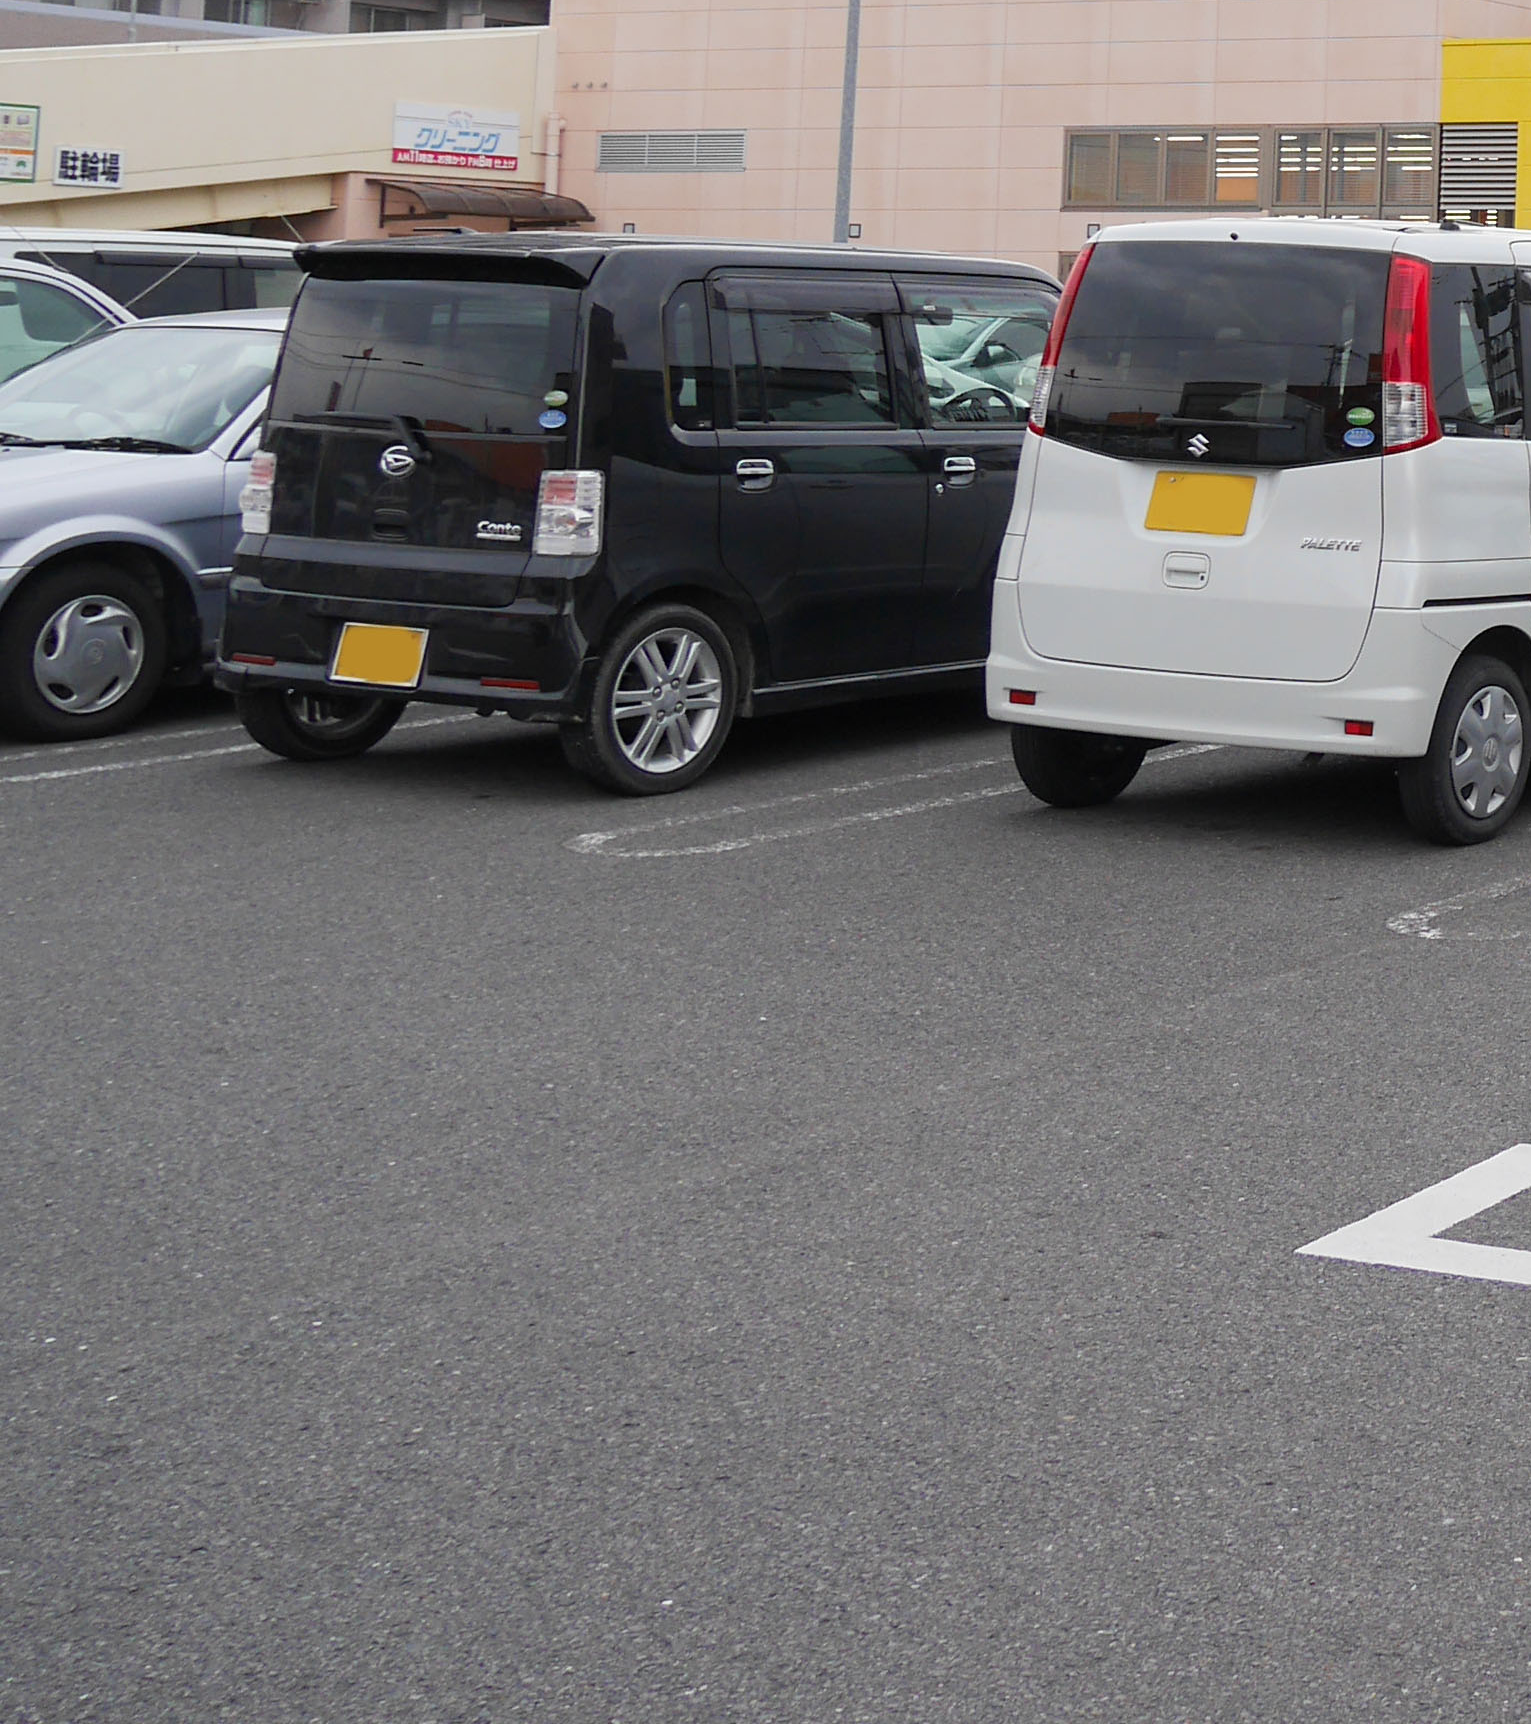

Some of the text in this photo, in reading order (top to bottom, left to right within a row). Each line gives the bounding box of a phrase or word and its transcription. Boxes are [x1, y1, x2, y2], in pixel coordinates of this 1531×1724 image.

[413, 127, 501, 154] クリーニング
[58, 149, 120, 183] 駐輪場
[477, 520, 523, 536] Conte
[1300, 537, 1362, 552] PALETTE
